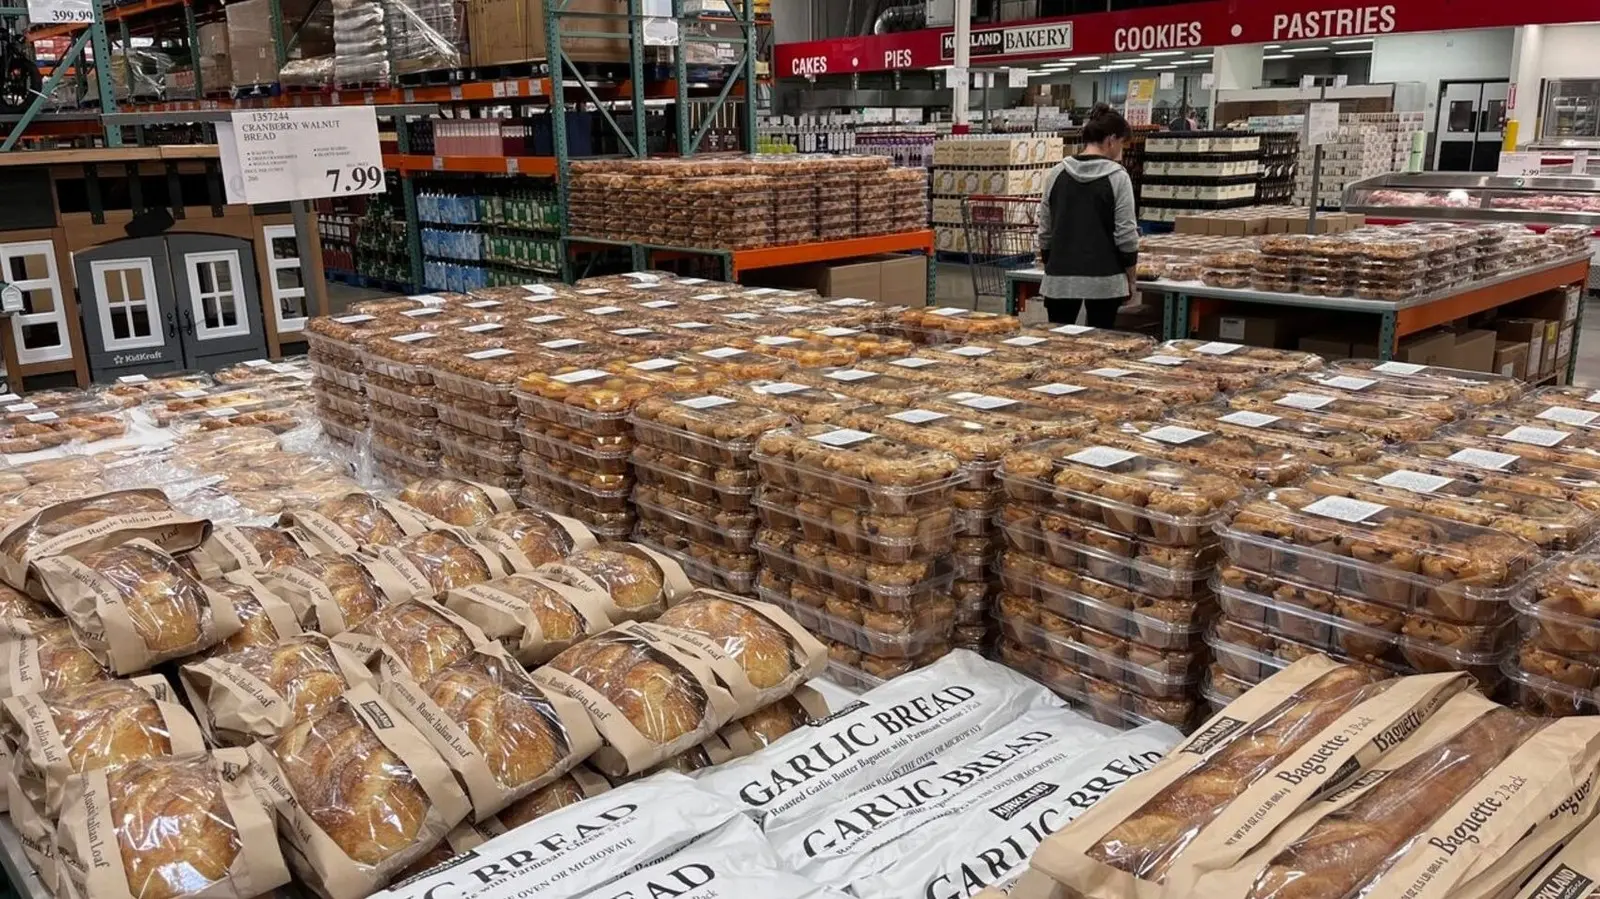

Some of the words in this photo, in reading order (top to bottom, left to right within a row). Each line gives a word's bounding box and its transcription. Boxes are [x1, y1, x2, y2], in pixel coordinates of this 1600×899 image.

[52, 10, 94, 22] 399.99
[1273, 5, 1396, 39] PASTRIES
[1006, 28, 1068, 49] BAKERY
[1114, 21, 1202, 51] COOKIES
[792, 56, 827, 74] CAKES
[884, 48, 912, 68] PIES
[242, 122, 299, 132] CRANBERRY
[300, 120, 340, 130] WALNUT
[252, 112, 290, 122] 1357244
[244, 132, 276, 142] BREAD
[326, 166, 382, 192] 7.99
[124, 350, 163, 364] KidKraft
[408, 574, 426, 590] Loaf
[577, 578, 596, 594] Loaf
[680, 632, 704, 649] Italian
[702, 642, 725, 662] Loaf
[253, 688, 276, 708] Loaf
[566, 684, 590, 706] Italian
[587, 700, 611, 721] Loaf
[416, 702, 436, 722] Rustic
[432, 719, 453, 743] Italian
[450, 738, 474, 759] Loaf
[44, 745, 62, 763] Loaf
[739, 723, 880, 806] GARLIC
[871, 686, 976, 736] BREAD
[900, 764, 917, 776] THE
[916, 753, 936, 768] OVEN
[944, 725, 984, 752] MICROWAVE
[770, 796, 806, 817] Roasted
[806, 778, 833, 797] Garlic
[832, 766, 859, 782] Butter
[857, 748, 892, 771] Baguette
[890, 738, 910, 756] with
[908, 724, 940, 744] Parmesan
[938, 712, 964, 728] Cheese
[1022, 752, 1068, 776] MICROWAVE
[1275, 734, 1350, 788] Baguette
[802, 778, 948, 858] GARLIC
[940, 730, 1054, 789] BREAD
[998, 782, 1050, 818] KIRKLAND
[1248, 816, 1258, 826] OZ
[1428, 794, 1503, 856] Baguette
[1501, 774, 1528, 799] Pack
[91, 841, 110, 869] Loaf
[510, 850, 567, 880] Parmesan
[926, 808, 1060, 899] GARLIC
[518, 879, 551, 899] OVEN
[550, 868, 570, 884] OR
[568, 837, 637, 877] MICROWAVE
